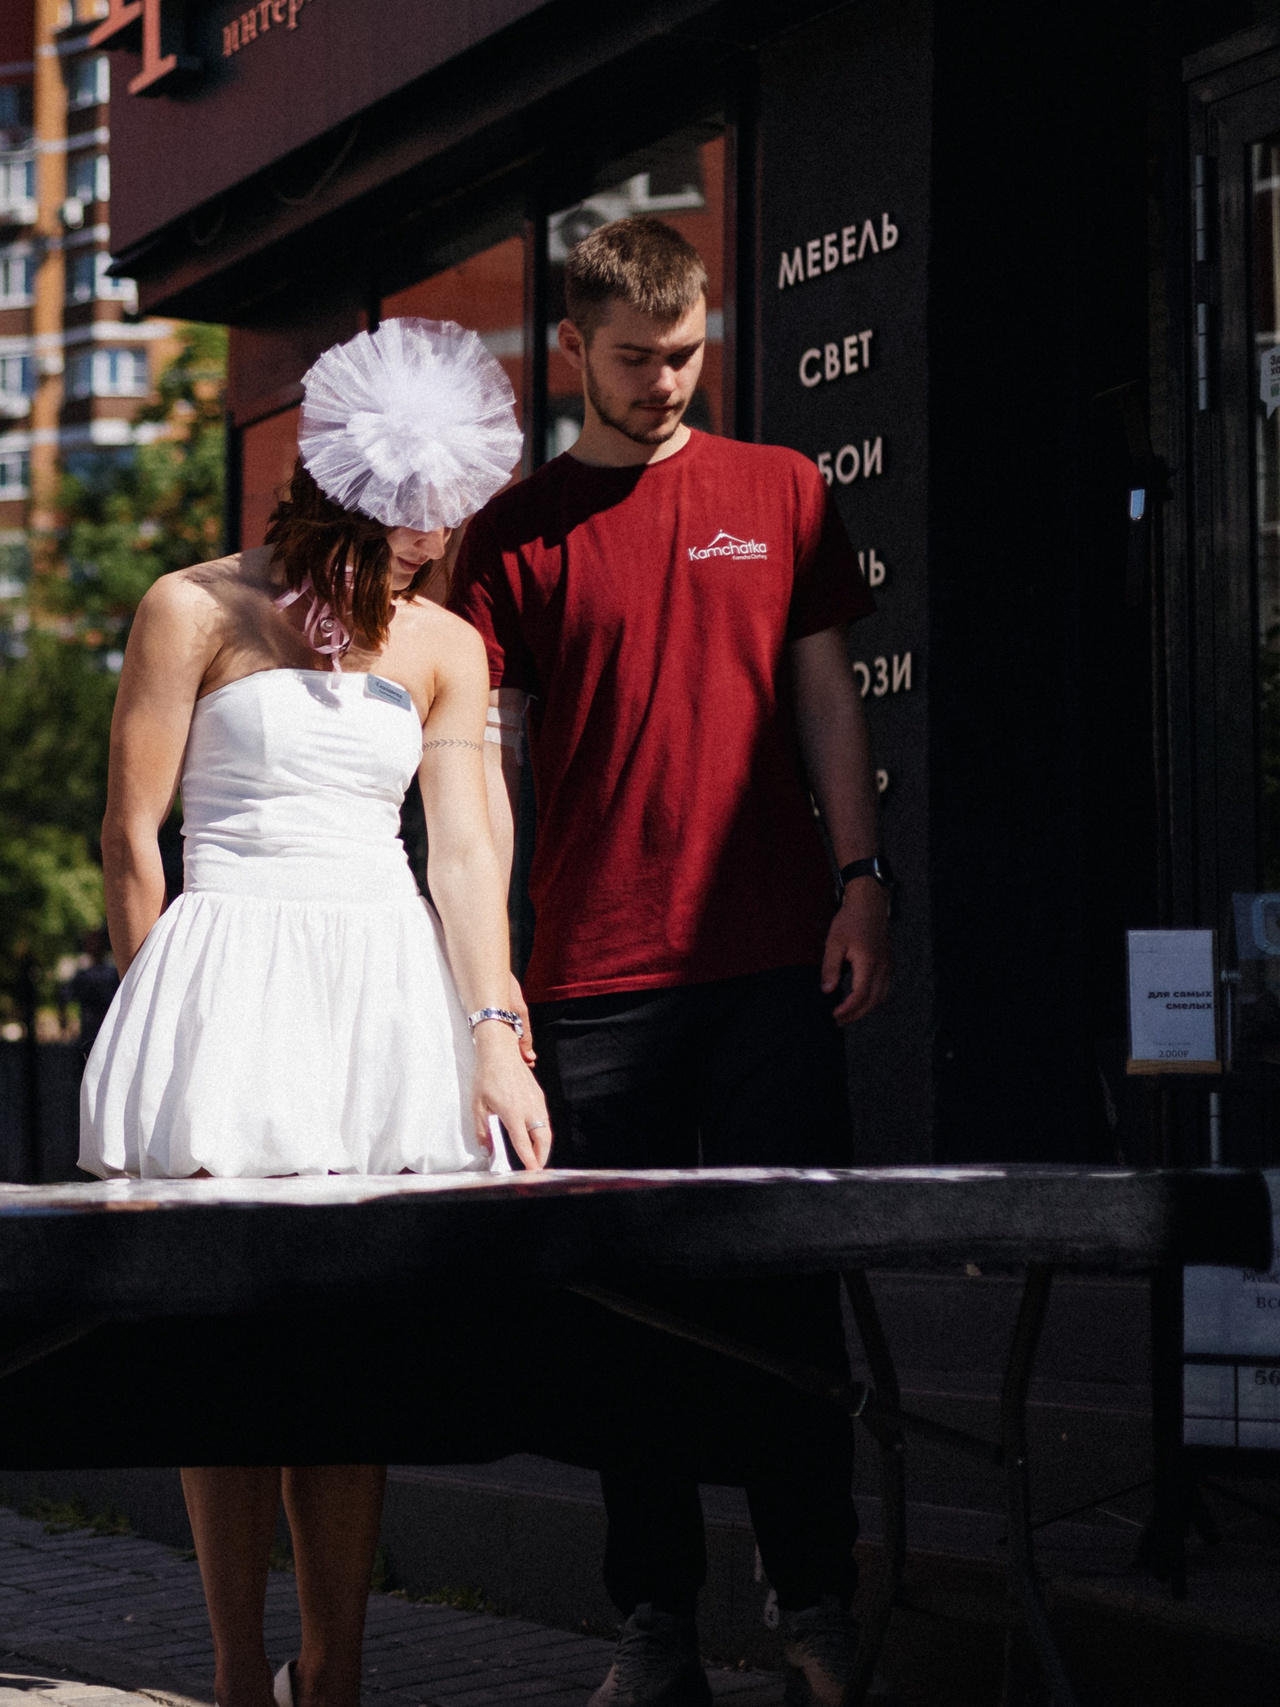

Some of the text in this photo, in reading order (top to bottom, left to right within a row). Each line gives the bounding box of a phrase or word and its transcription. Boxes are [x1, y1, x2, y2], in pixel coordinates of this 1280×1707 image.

[222, 0, 306, 57] интер
[778, 212, 899, 290] МЕБЕЛЬ
[798, 329, 873, 388] СВЕТ
[817, 436, 883, 486] БОИ
[688, 539, 767, 561] Kamchatka
[1147, 990, 1213, 999] для самых
[1166, 1002, 1213, 1010] смелых
